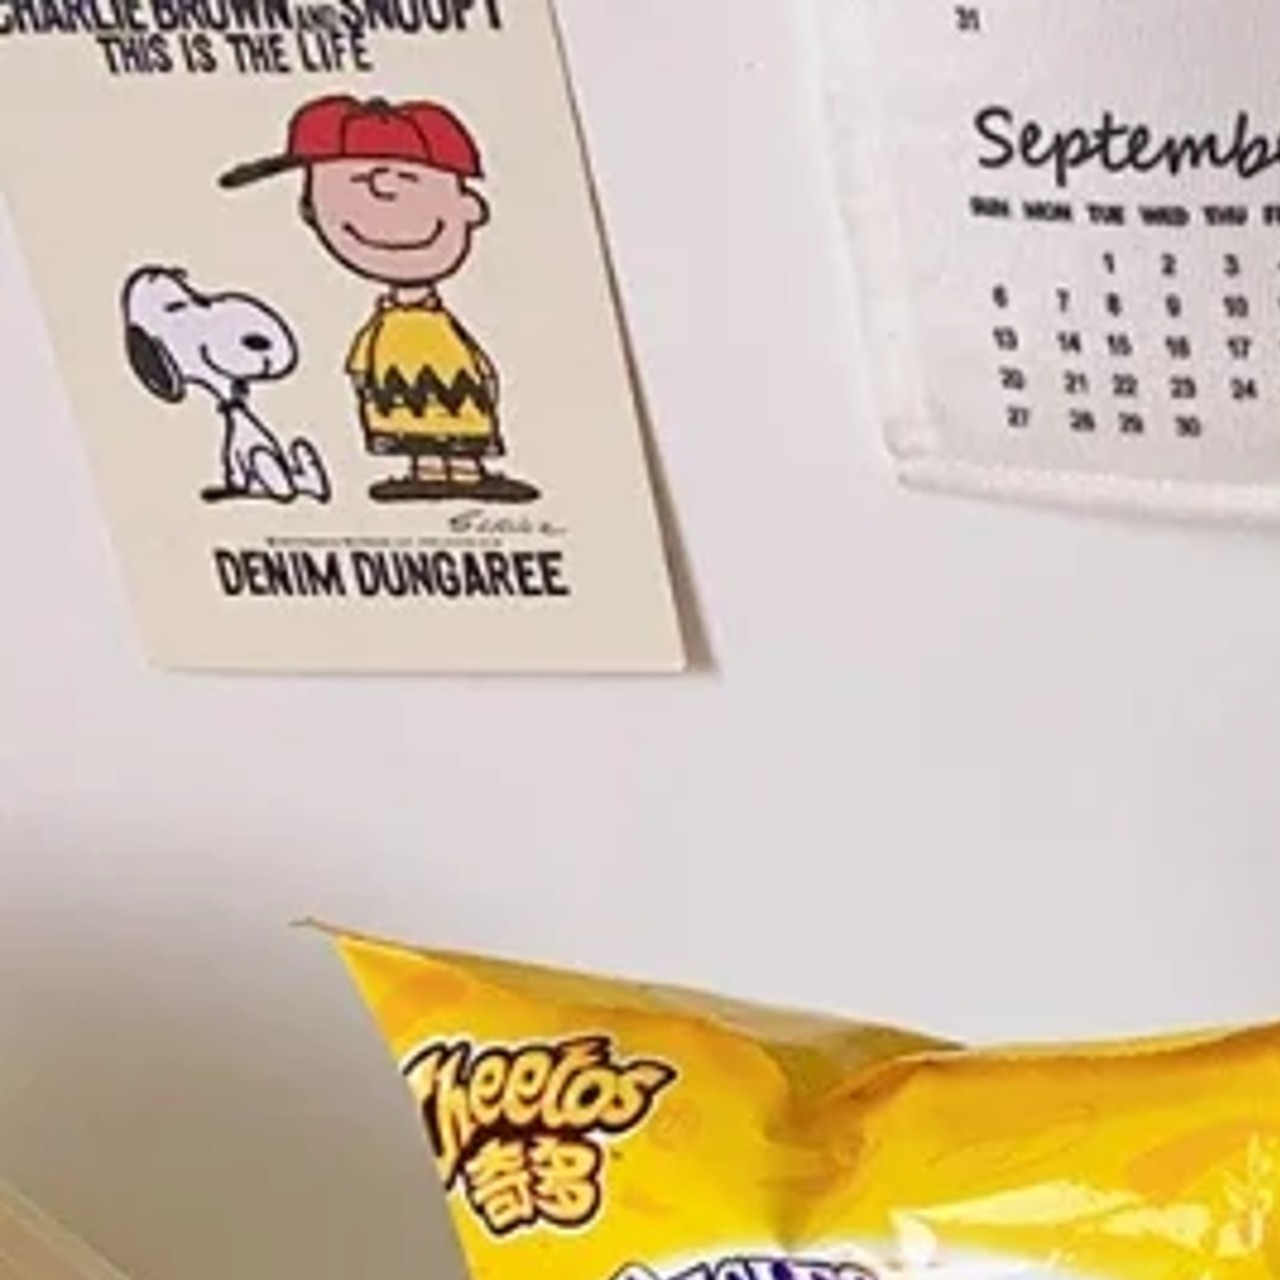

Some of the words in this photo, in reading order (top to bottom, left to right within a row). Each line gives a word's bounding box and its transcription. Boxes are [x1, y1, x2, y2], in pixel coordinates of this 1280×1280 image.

[96, 33, 173, 73] THIS
[178, 33, 217, 73] IS
[225, 33, 291, 73] THE
[297, 32, 372, 73] LIFE
[1022, 201, 1073, 222] MON
[1138, 205, 1191, 228] WED
[1201, 204, 1249, 227] THU
[1102, 251, 1116, 275] 1
[1161, 252, 1177, 277] 2
[1223, 253, 1241, 278] 3
[1056, 288, 1071, 314] 7
[1105, 292, 1123, 318] 8
[1164, 293, 1182, 319] 9
[1222, 294, 1250, 319] 10
[992, 326, 1019, 352] 13
[1057, 331, 1082, 354] 14
[1106, 333, 1134, 357] 15
[1226, 335, 1253, 360] 17
[1063, 370, 1089, 395] 21
[1230, 377, 1258, 401] 24
[214, 549, 347, 596] DENIM
[350, 550, 570, 597] DUNGAREE
[464, 1133, 603, 1233] 奇多
